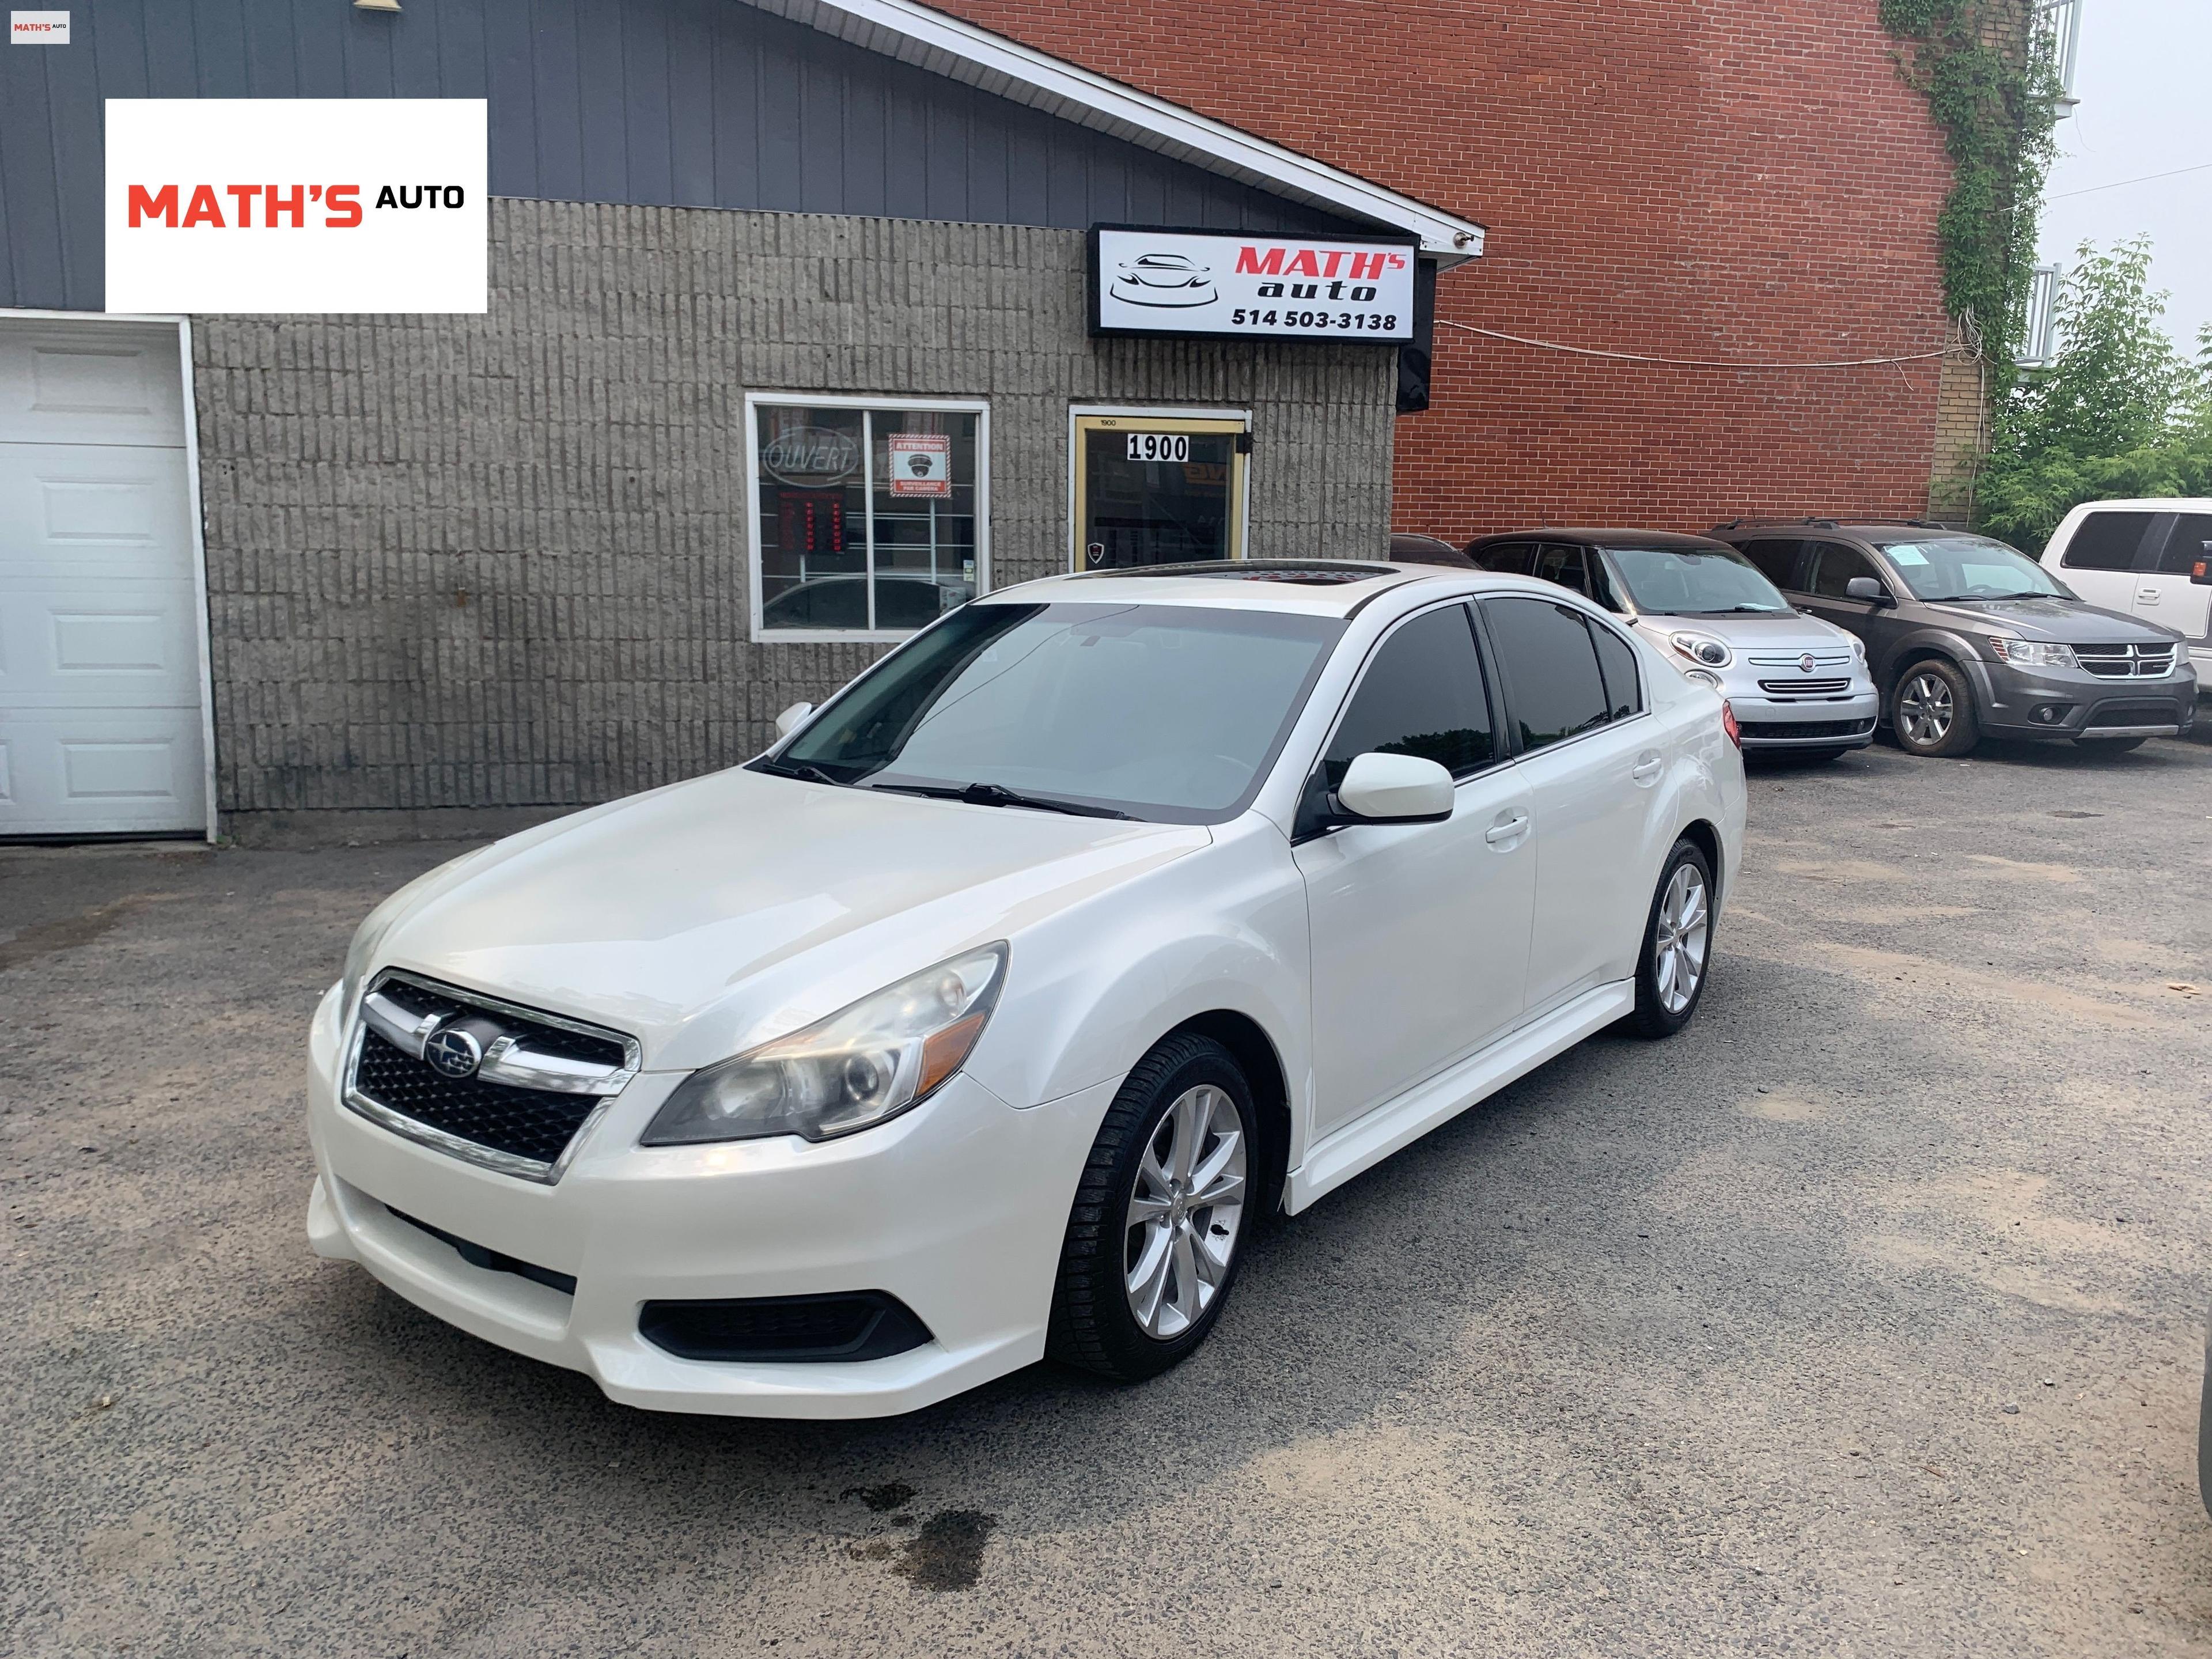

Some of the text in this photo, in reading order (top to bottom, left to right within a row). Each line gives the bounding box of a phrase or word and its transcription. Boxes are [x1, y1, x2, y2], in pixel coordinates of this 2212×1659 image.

[1257, 281, 1377, 301] auto
[1232, 309, 1396, 331] 514 503-3138
[896, 442, 943, 450] ATTENTION
[1129, 435, 1187, 461] 1900
[769, 445, 852, 471] OUVERT
